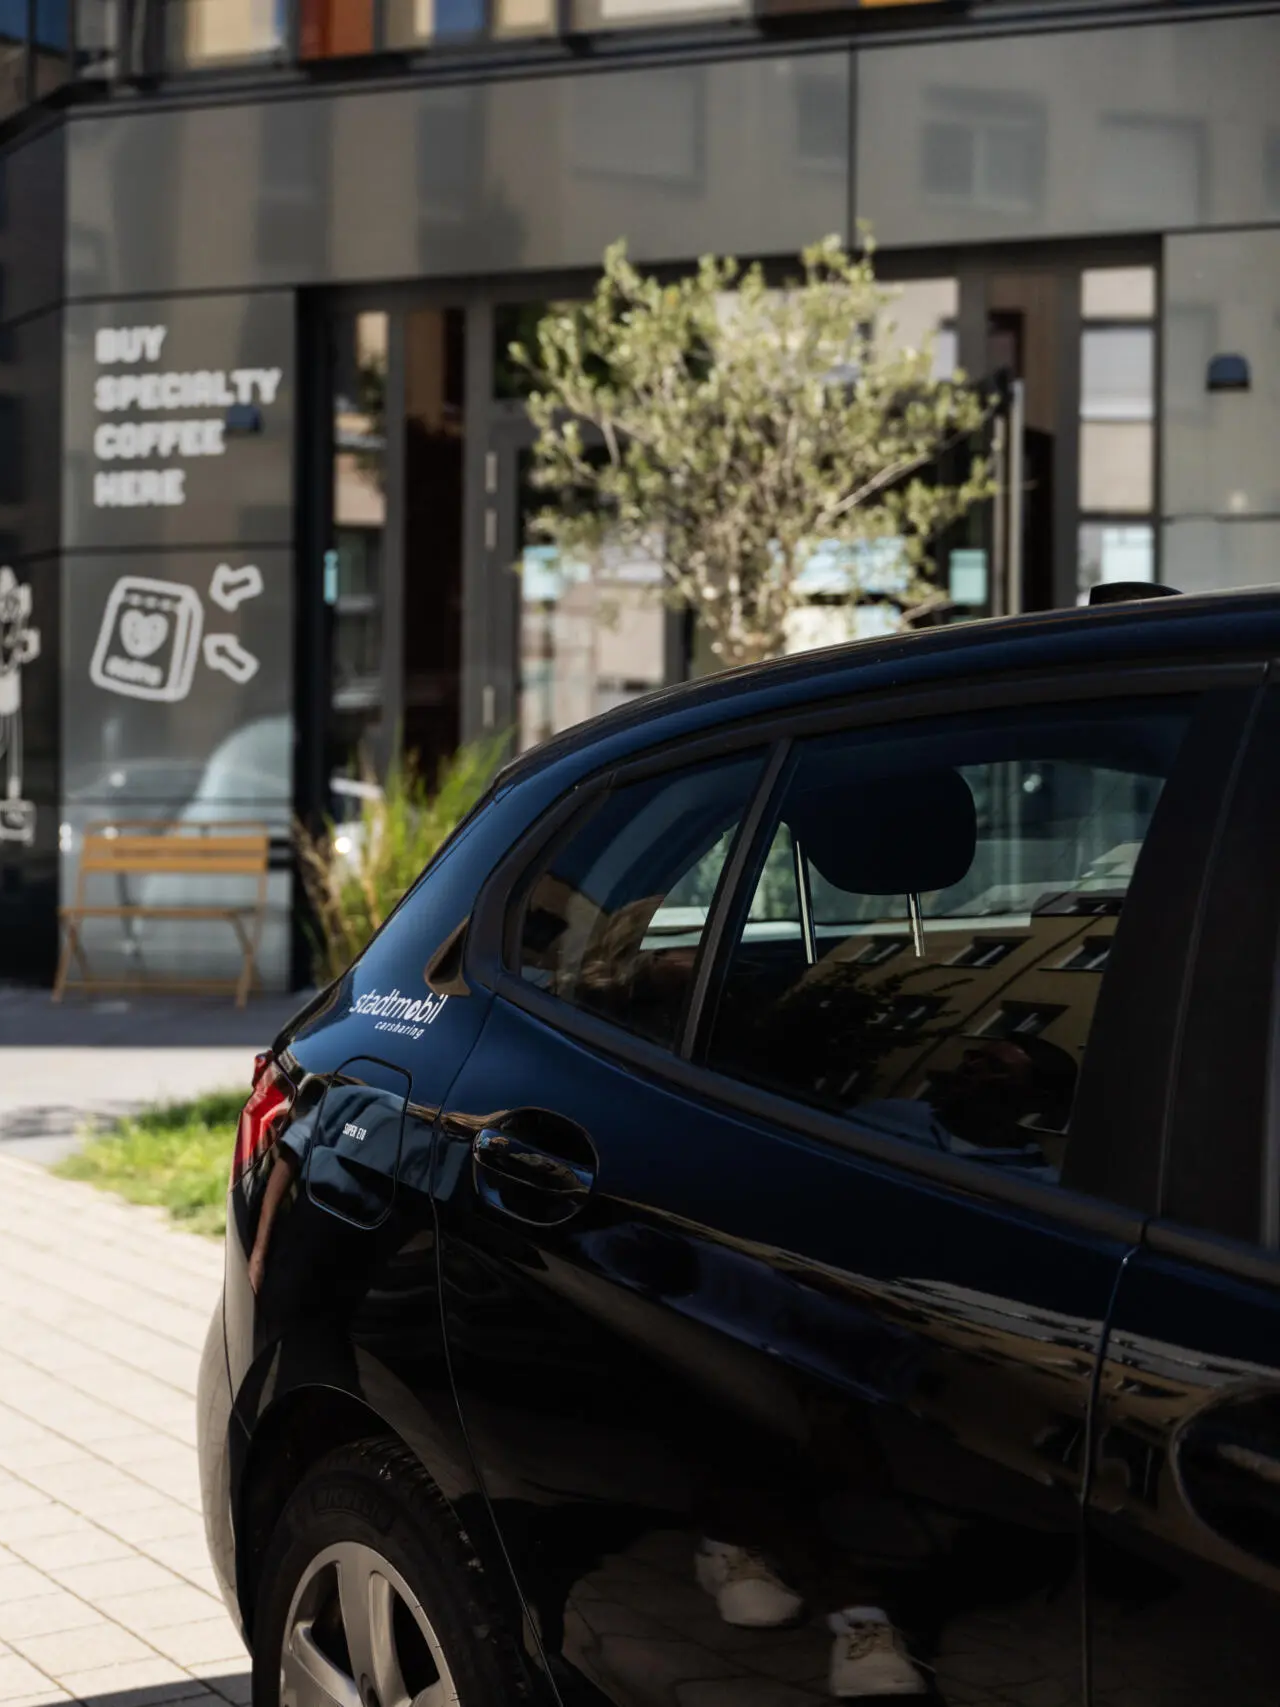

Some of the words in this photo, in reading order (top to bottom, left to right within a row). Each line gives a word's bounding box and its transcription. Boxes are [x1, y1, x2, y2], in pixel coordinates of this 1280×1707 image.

[95, 326, 166, 364] BUY
[94, 367, 282, 412] SPECIALTY
[94, 418, 225, 460] COFFEE
[94, 468, 186, 507] HERE
[349, 988, 449, 1024] stadtmobil
[374, 1021, 425, 1040] carsharing
